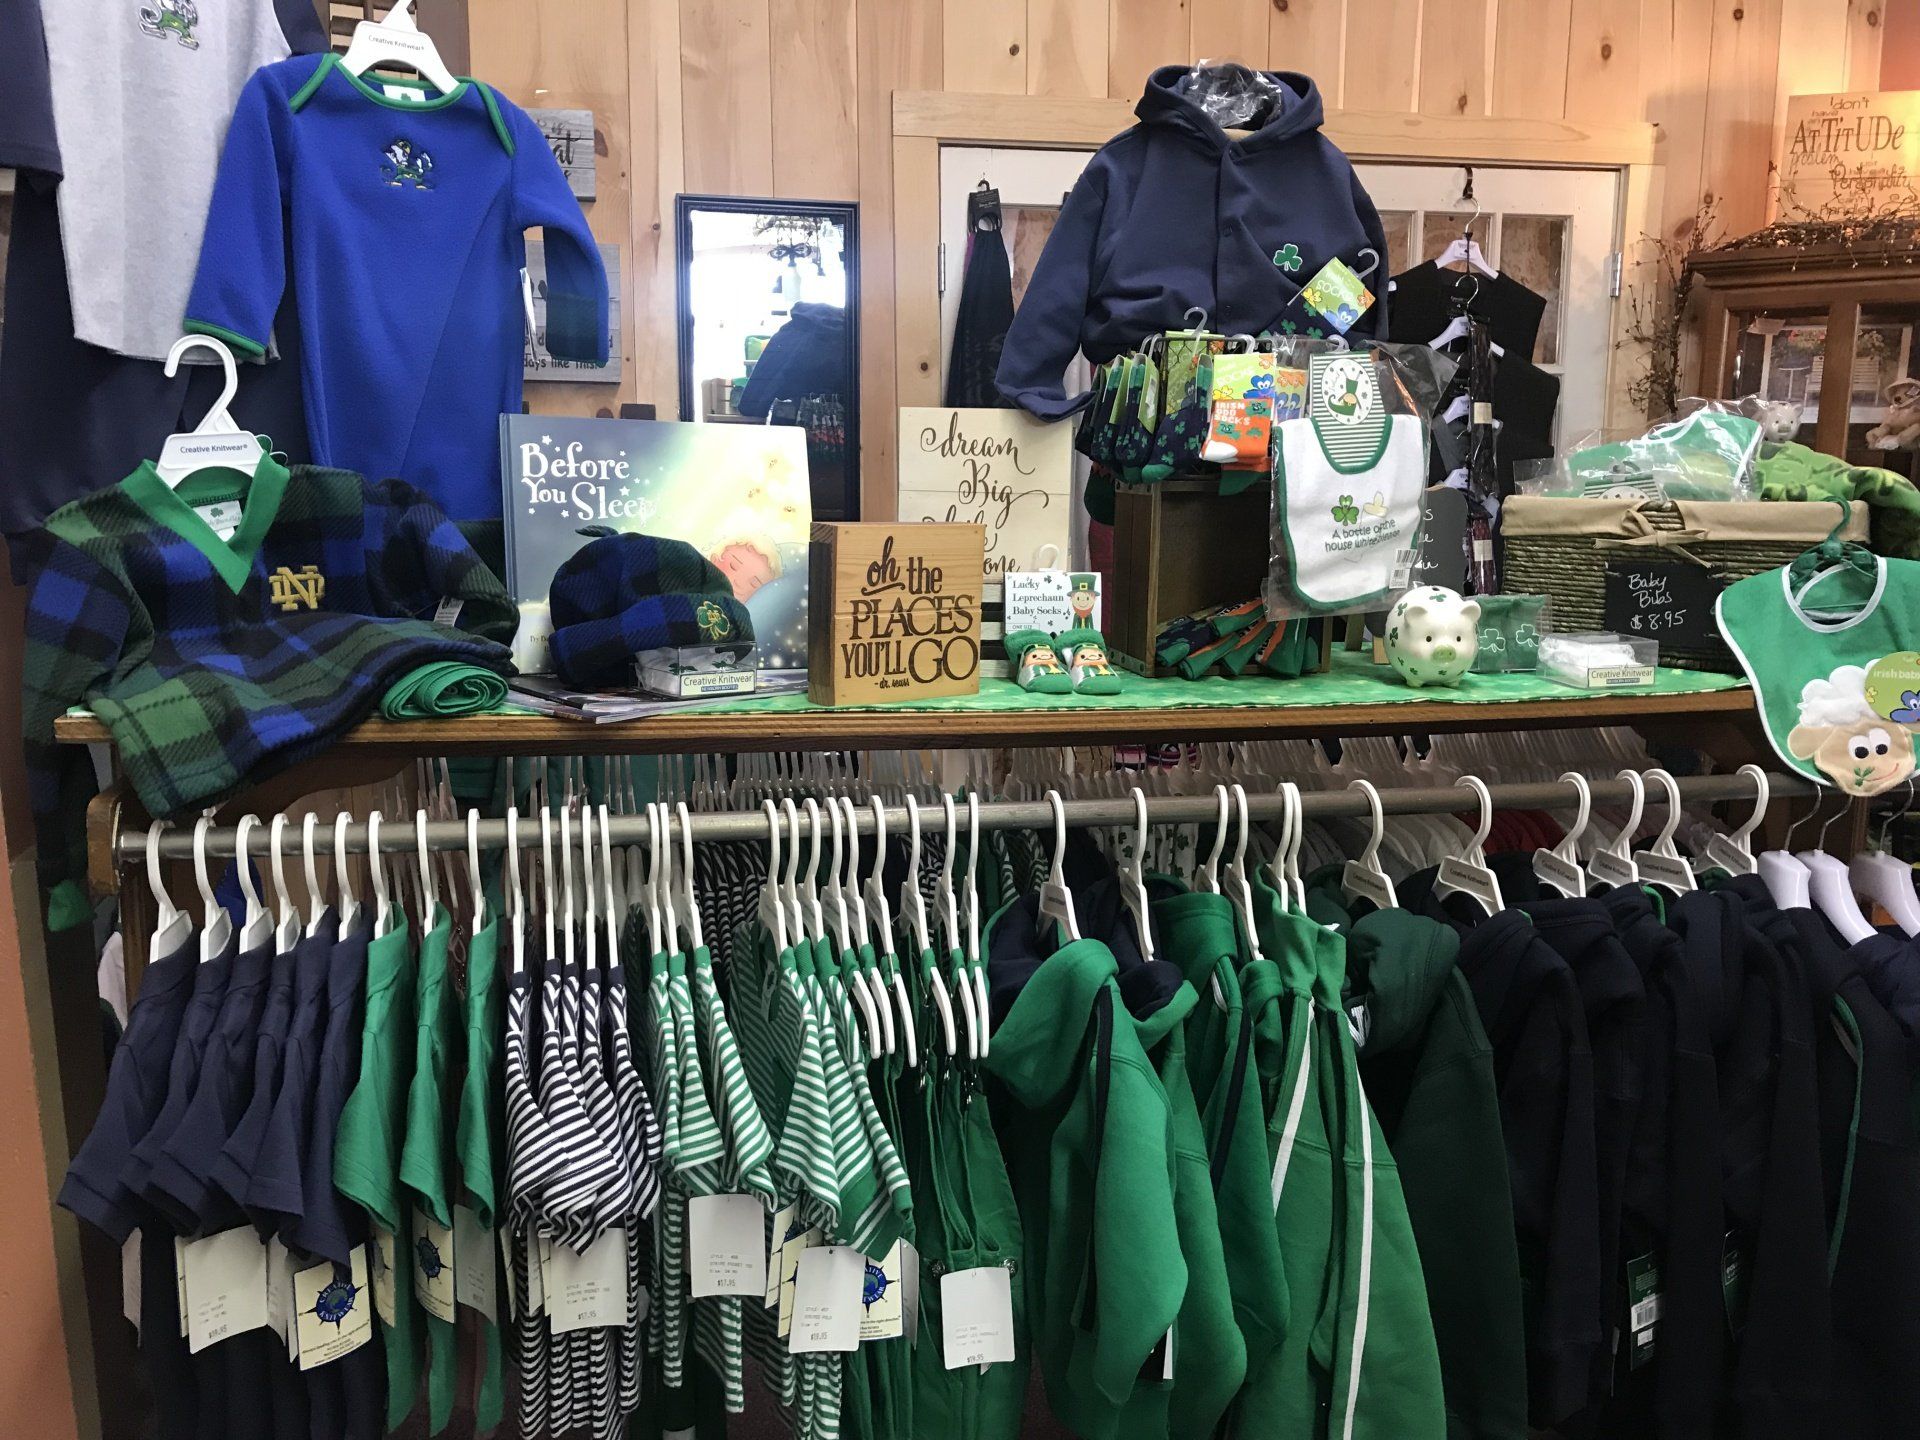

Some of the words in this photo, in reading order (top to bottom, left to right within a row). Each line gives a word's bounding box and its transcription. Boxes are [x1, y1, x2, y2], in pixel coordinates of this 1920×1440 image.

[369, 35, 393, 45] Creative
[1832, 97, 1870, 110] don't
[1215, 402, 1245, 410] IRISH
[1214, 415, 1251, 426] SOCKS
[211, 444, 243, 452] Knitwear
[920, 411, 1036, 475] dream
[520, 441, 630, 480] Before
[521, 477, 568, 504] You
[958, 458, 1050, 529] Big
[1332, 529, 1341, 539] A
[1343, 526, 1371, 539] bottle
[1325, 540, 1353, 552] house
[866, 536, 901, 587] oh
[906, 556, 943, 595] the
[1012, 579, 1040, 590] Lucky
[1628, 572, 1667, 593] Baby
[1012, 593, 1064, 603] Leprechaun
[1632, 589, 1673, 608] Bibs
[849, 594, 974, 640] PLACES
[1012, 606, 1035, 616] Baby
[1037, 606, 1062, 615] Socks
[841, 640, 906, 679] YOU'LL
[908, 635, 979, 684] GO
[1591, 670, 1621, 679] Creative
[1621, 669, 1653, 678] Knitwear
[1873, 668, 1898, 677] irish
[683, 677, 717, 687] Creative
[719, 675, 752, 685] Knitwear
